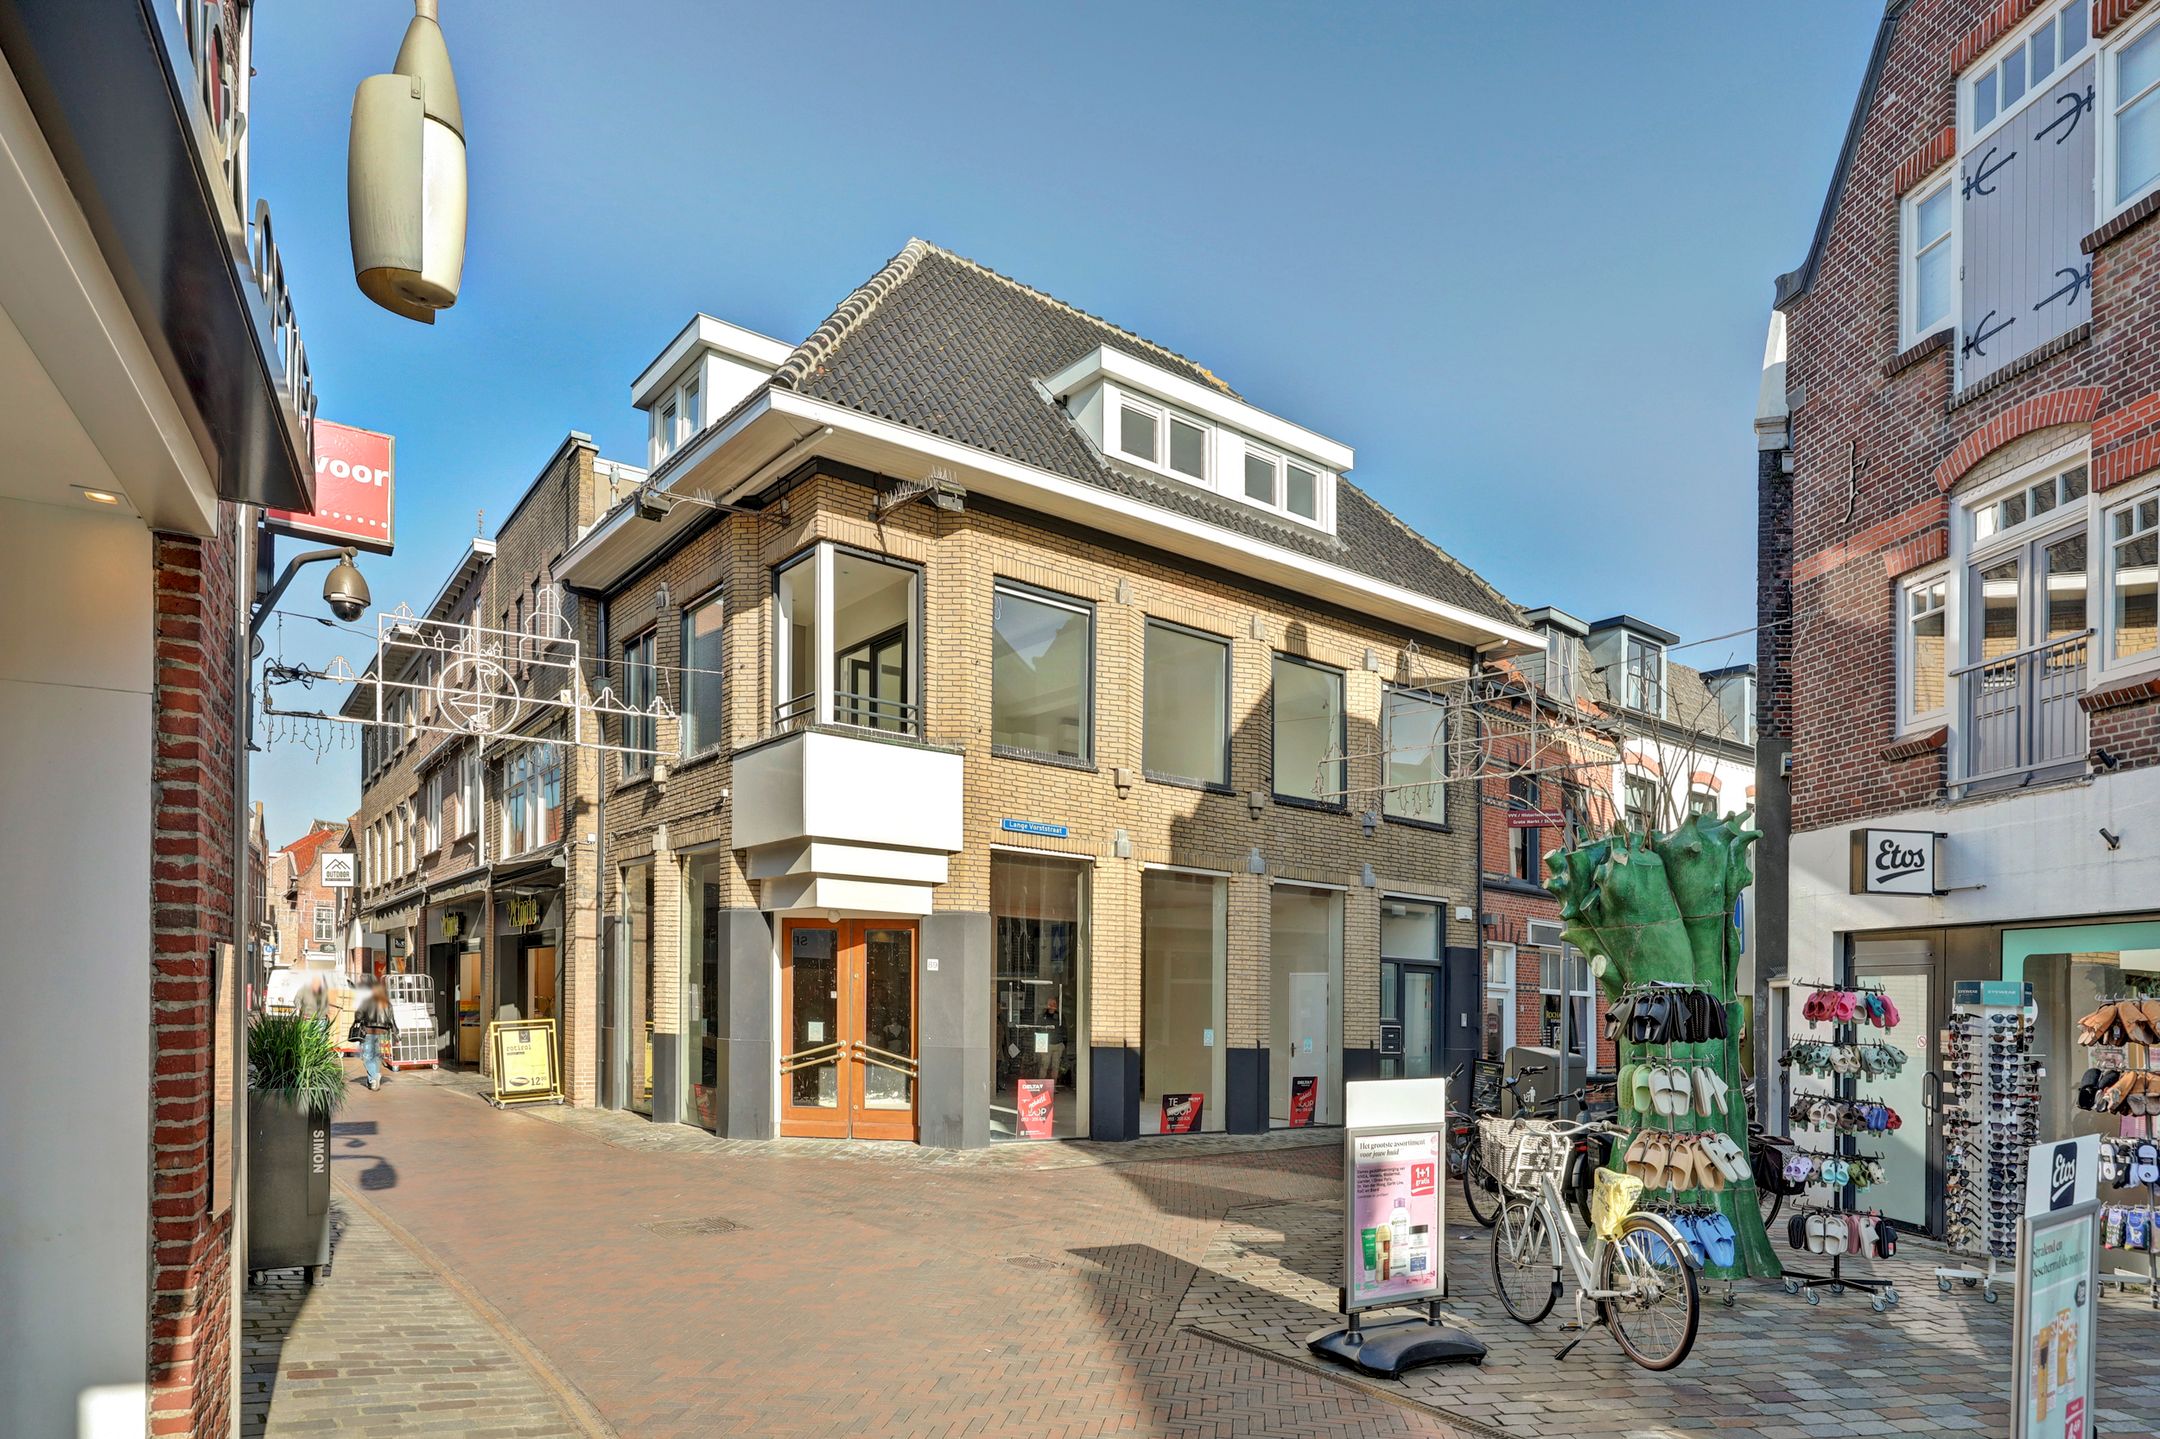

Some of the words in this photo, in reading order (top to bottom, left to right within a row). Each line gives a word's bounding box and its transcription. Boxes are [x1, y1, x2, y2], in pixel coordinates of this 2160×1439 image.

[1010, 820, 1028, 830] Lange
[1876, 839, 1925, 870] Etos
[1169, 1098, 1178, 1106] TE
[313, 1130, 324, 1173] SIMON
[1416, 1166, 1430, 1179] 1+1
[2052, 1153, 2076, 1188] Etos
[1416, 1178, 1430, 1187] gratis
